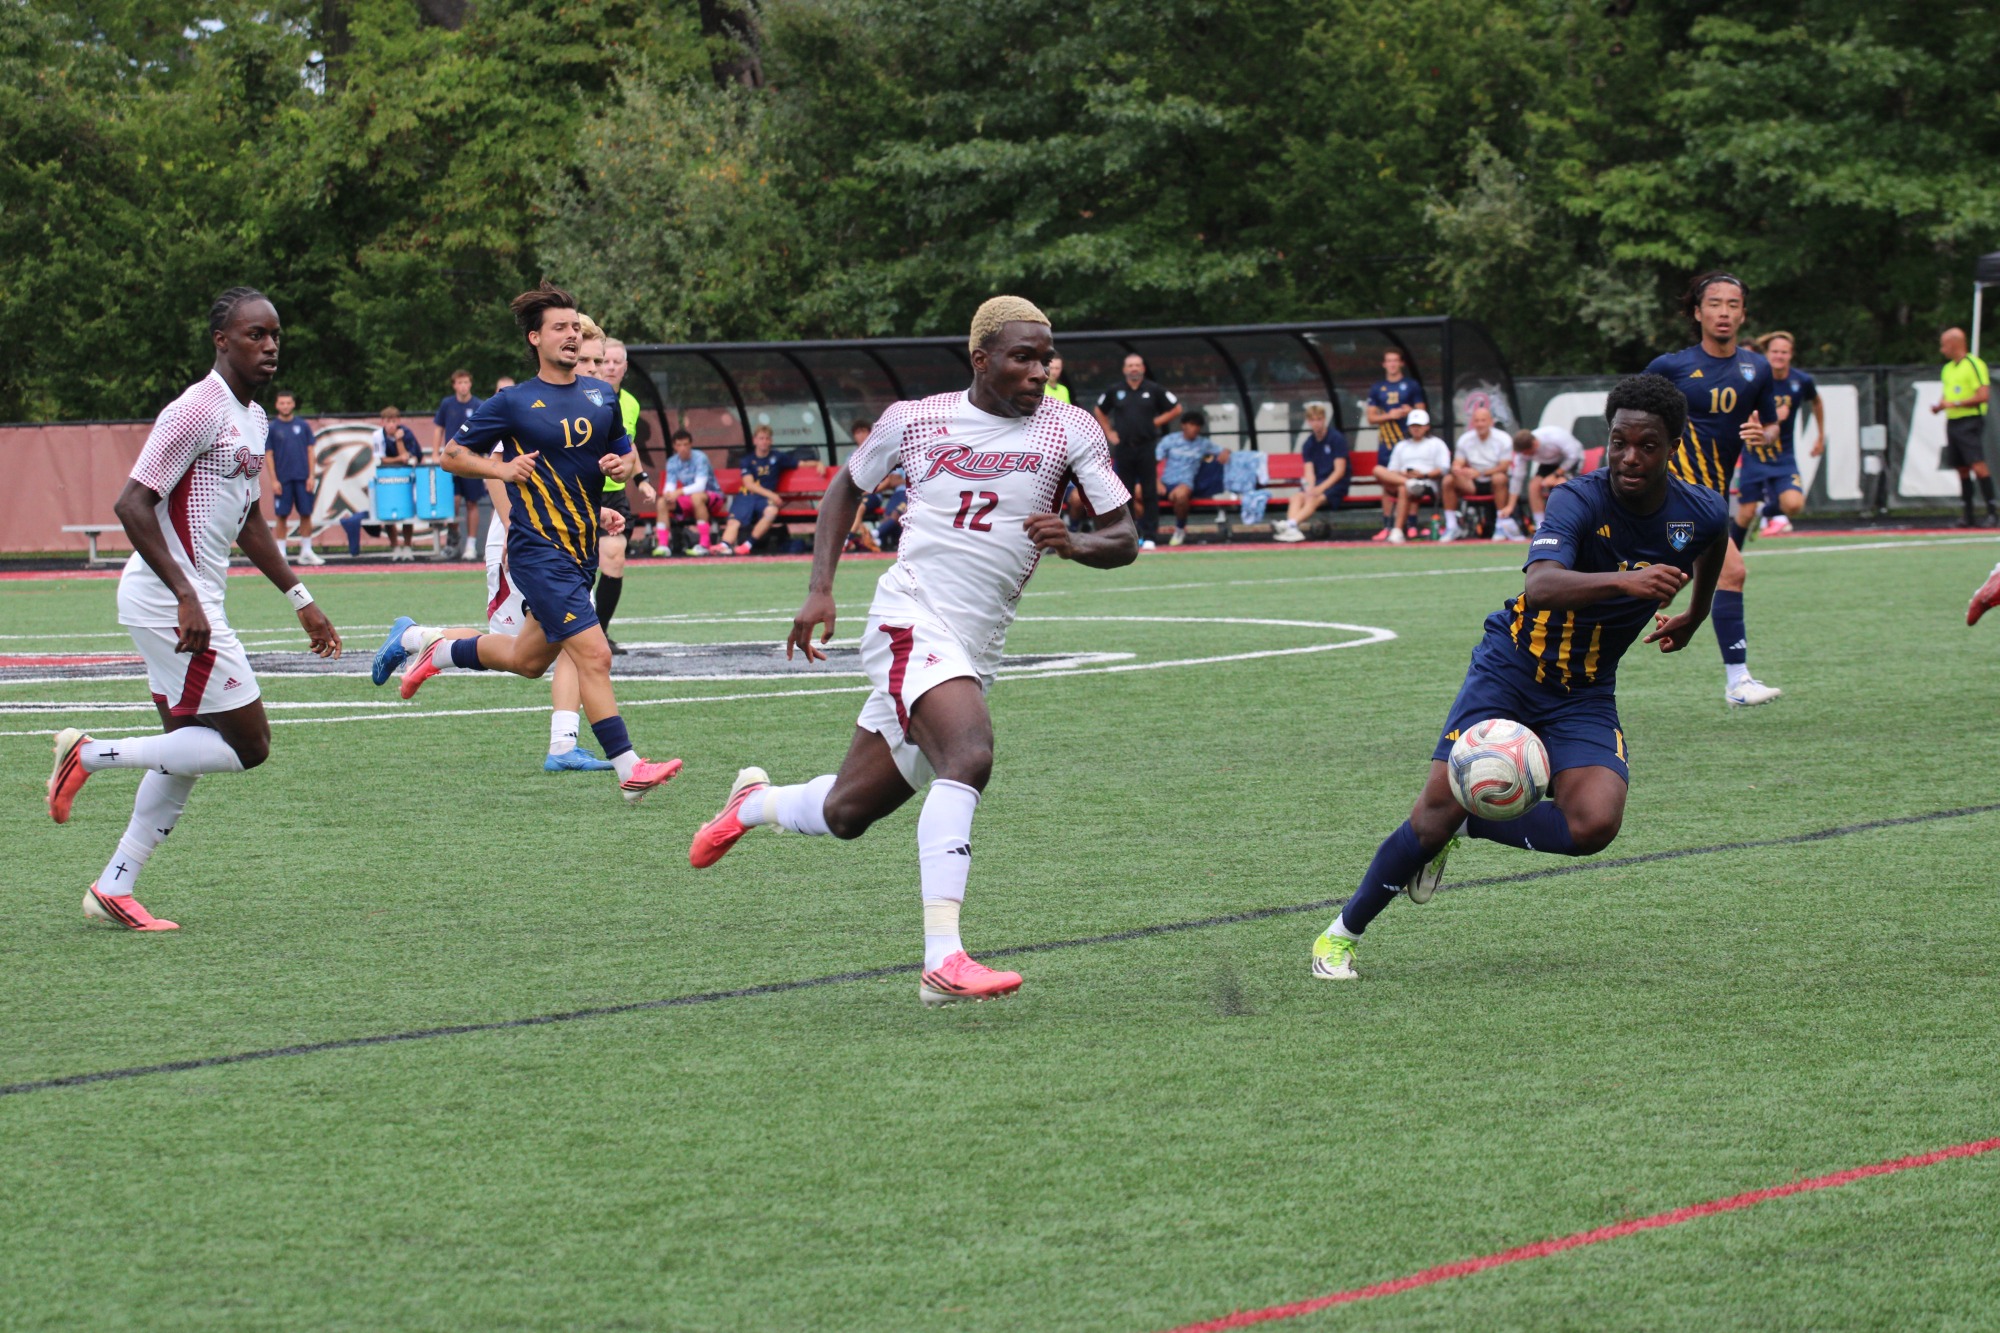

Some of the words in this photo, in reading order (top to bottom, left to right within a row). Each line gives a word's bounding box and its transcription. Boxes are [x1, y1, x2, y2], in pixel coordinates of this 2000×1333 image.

[1709, 387, 1737, 413] 10
[560, 417, 593, 449] 19
[224, 446, 264, 480] RIDE
[919, 443, 1043, 482] RIDER
[953, 491, 999, 532] 12
[1533, 538, 1558, 546] METRO
